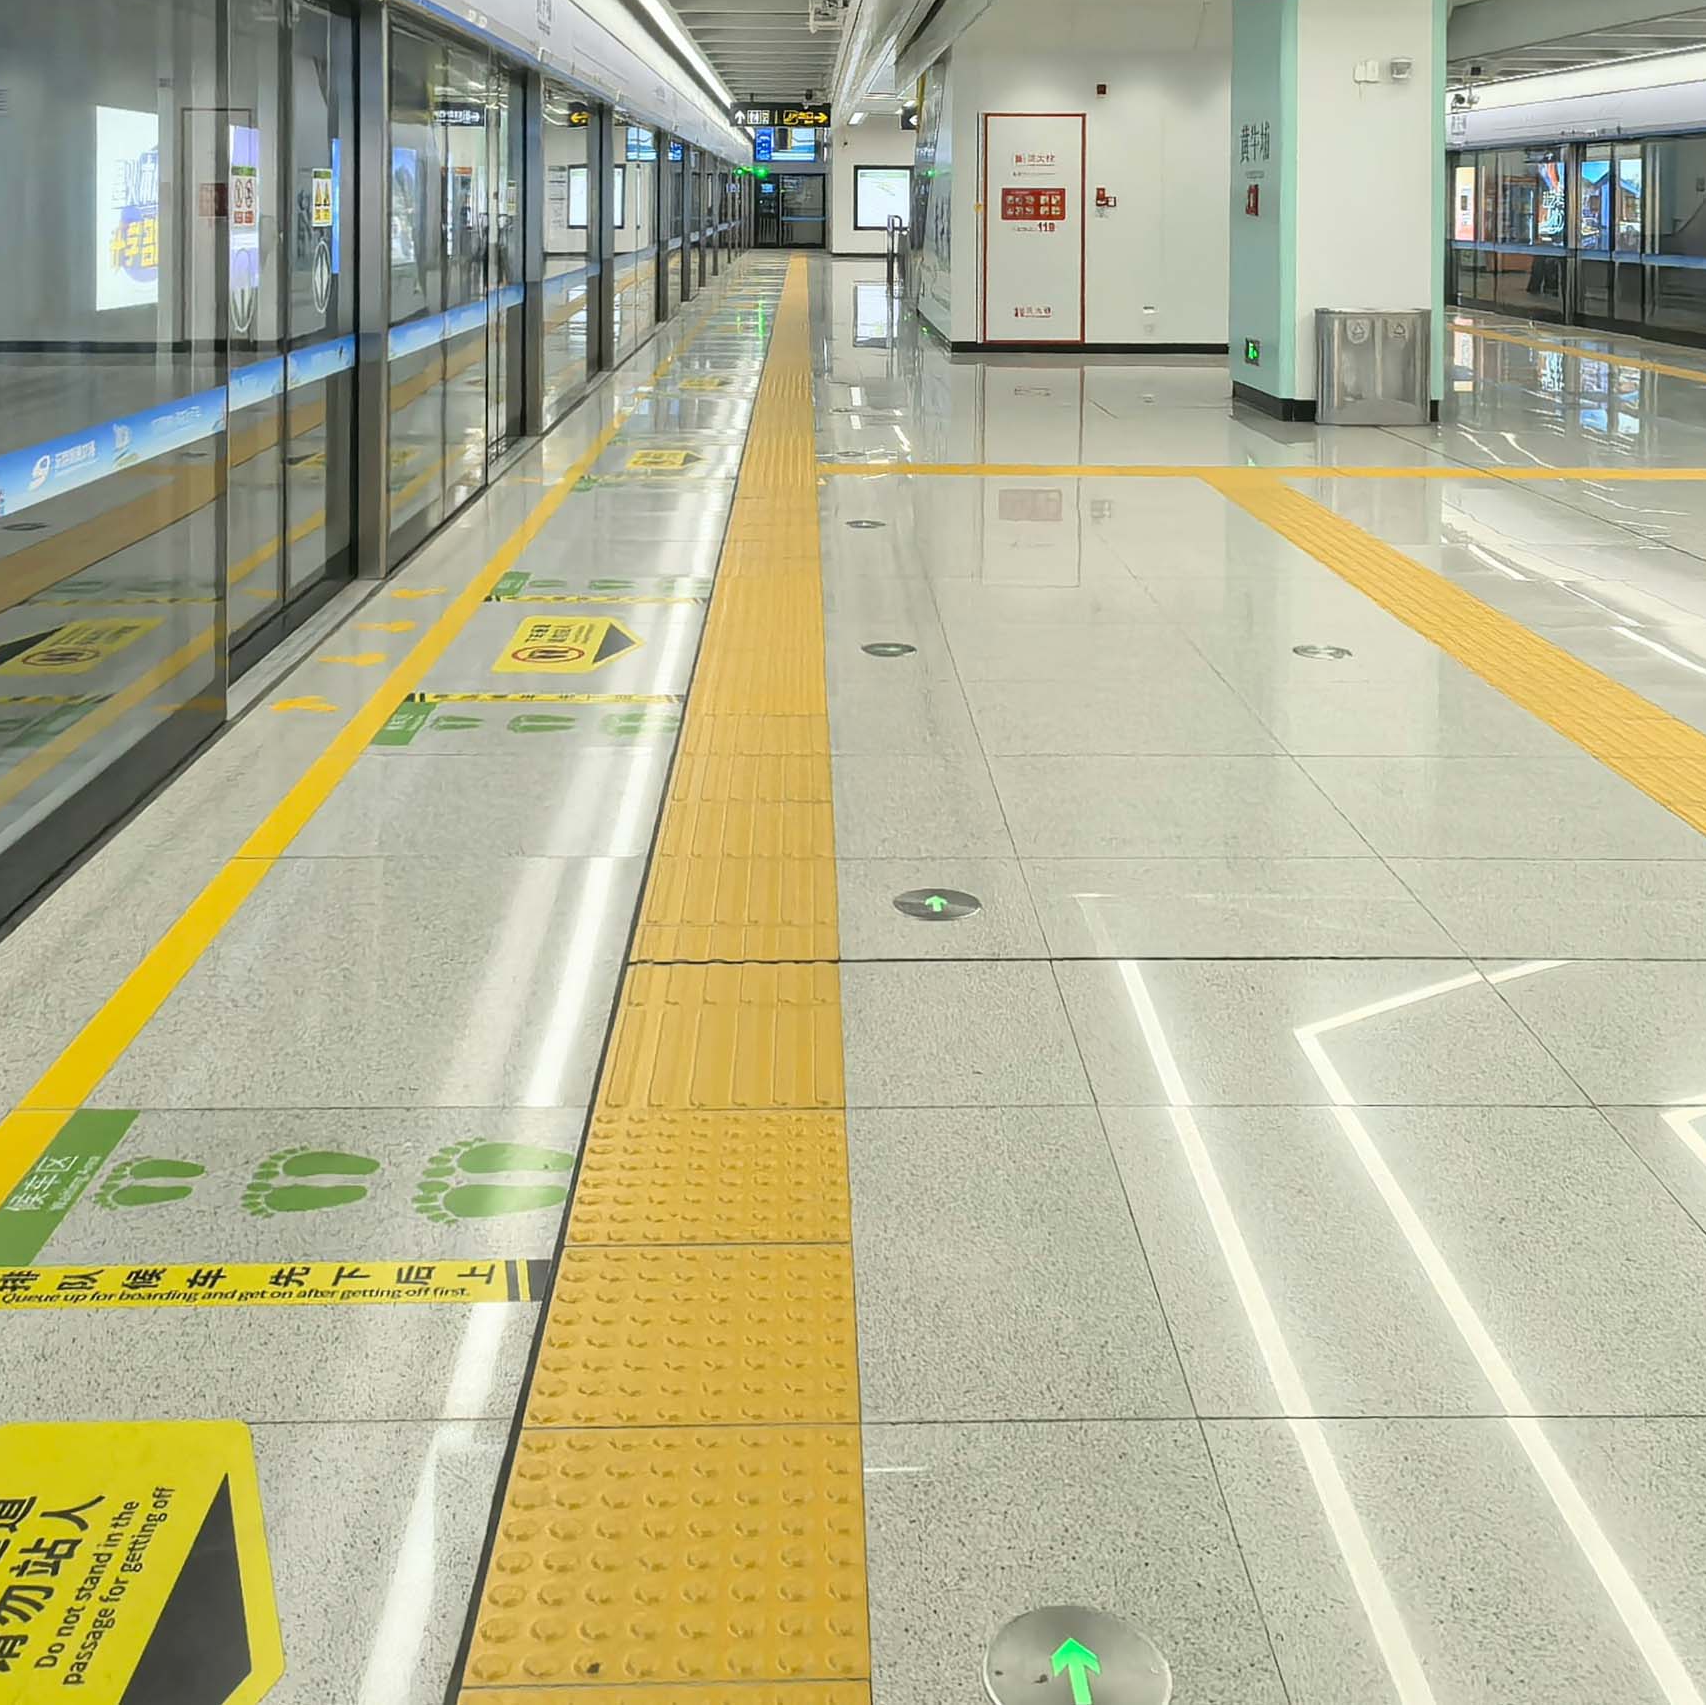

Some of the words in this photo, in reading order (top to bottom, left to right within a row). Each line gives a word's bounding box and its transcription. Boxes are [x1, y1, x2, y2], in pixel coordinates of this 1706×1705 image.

[1239, 120, 1270, 165] 黄牛埔
[269, 1263, 496, 1287] 先下后上
[1, 1292, 58, 1303] Queue
[63, 1293, 88, 1303] up
[90, 1290, 113, 1302] for
[118, 1290, 199, 1302] boarding
[201, 1290, 238, 1301] and
[239, 1288, 265, 1301] get
[269, 1289, 293, 1299] on
[294, 1287, 337, 1299] after
[339, 1287, 401, 1300] getting
[405, 1286, 432, 1298] off
[109, 1500, 140, 1530] the
[97, 1532, 124, 1548] in
[62, 1607, 116, 1686] passage
[98, 1576, 129, 1604] for
[120, 1512, 168, 1573] getting
[151, 1486, 176, 1510] off
[75, 1552, 113, 1603] stand
[56, 1606, 86, 1638] not
[34, 1642, 66, 1669] Do
